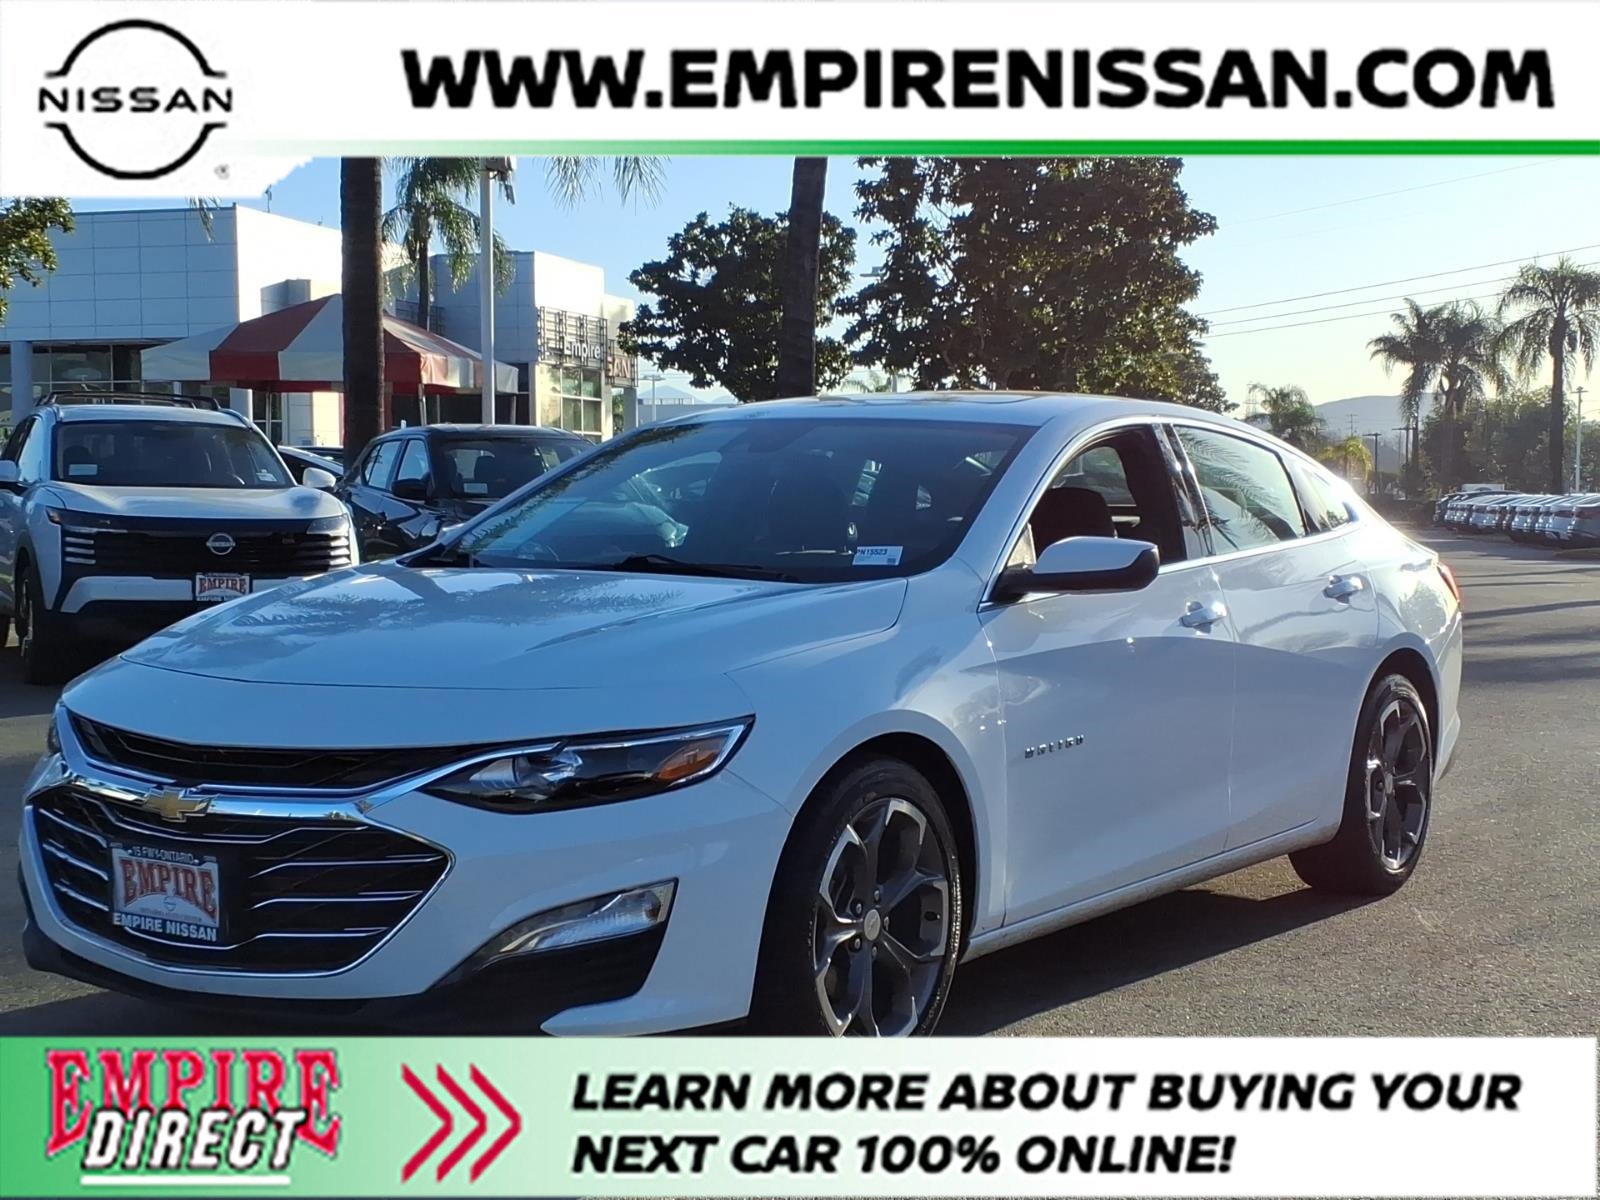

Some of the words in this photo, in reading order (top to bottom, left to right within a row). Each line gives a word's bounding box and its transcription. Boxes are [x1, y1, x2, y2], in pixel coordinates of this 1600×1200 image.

[563, 336, 601, 361] Empire
[199, 577, 247, 596] EMPIRE
[120, 859, 218, 920] EMPIRE
[113, 912, 163, 932] EMPIRE
[165, 921, 217, 942] NISSAN
